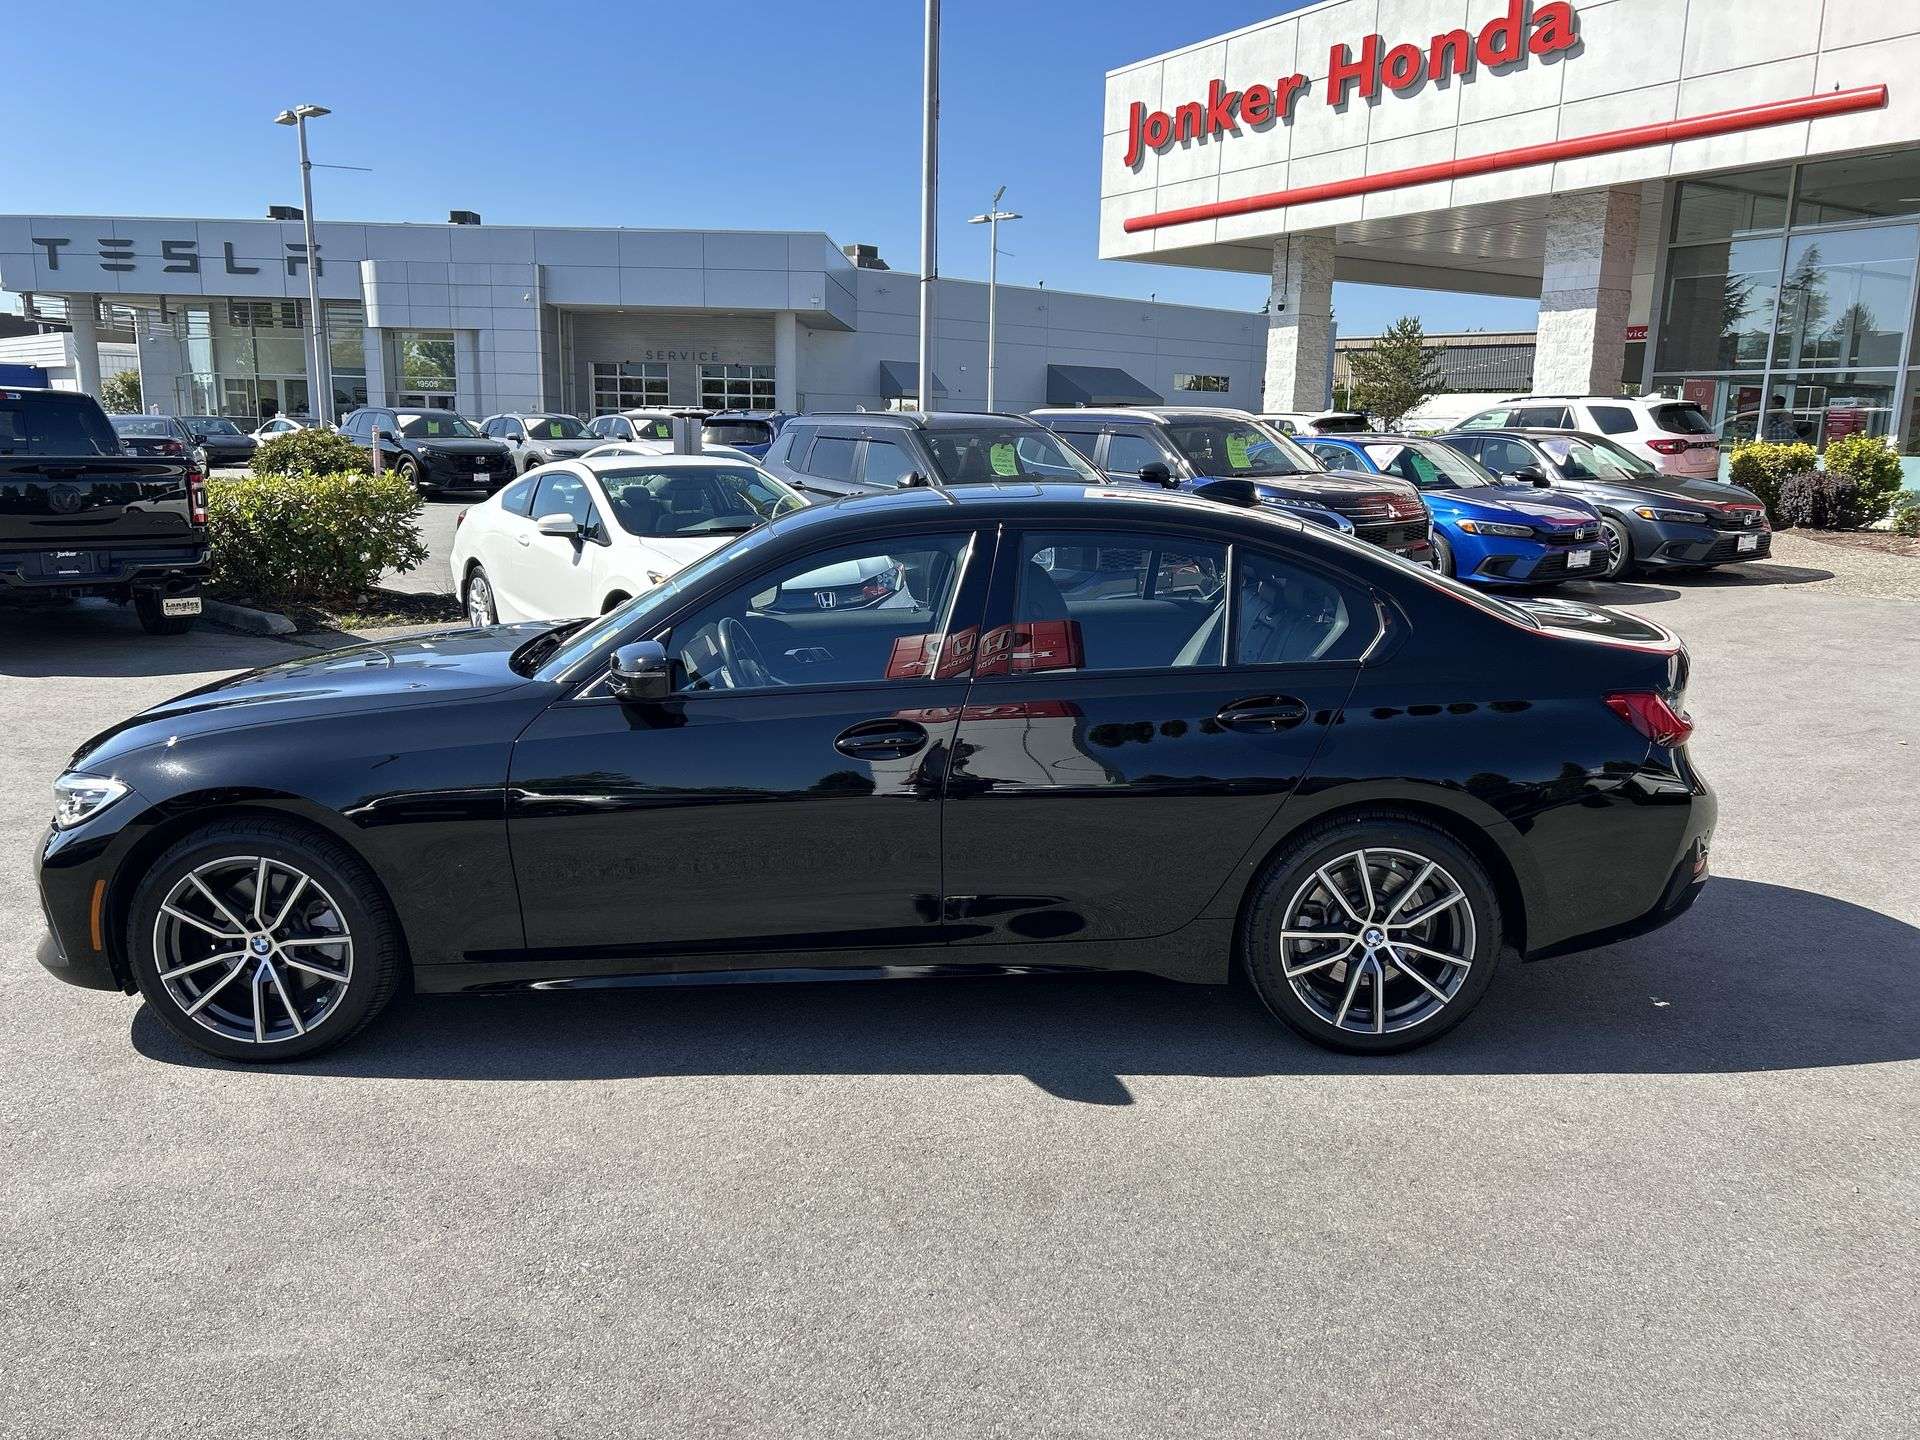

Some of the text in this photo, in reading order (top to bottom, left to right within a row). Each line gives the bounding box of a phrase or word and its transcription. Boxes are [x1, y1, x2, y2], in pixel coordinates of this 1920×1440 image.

[1124, 0, 1579, 168] Jonker Honda
[31, 237, 324, 278] TESLA
[645, 350, 720, 361] SERVICE
